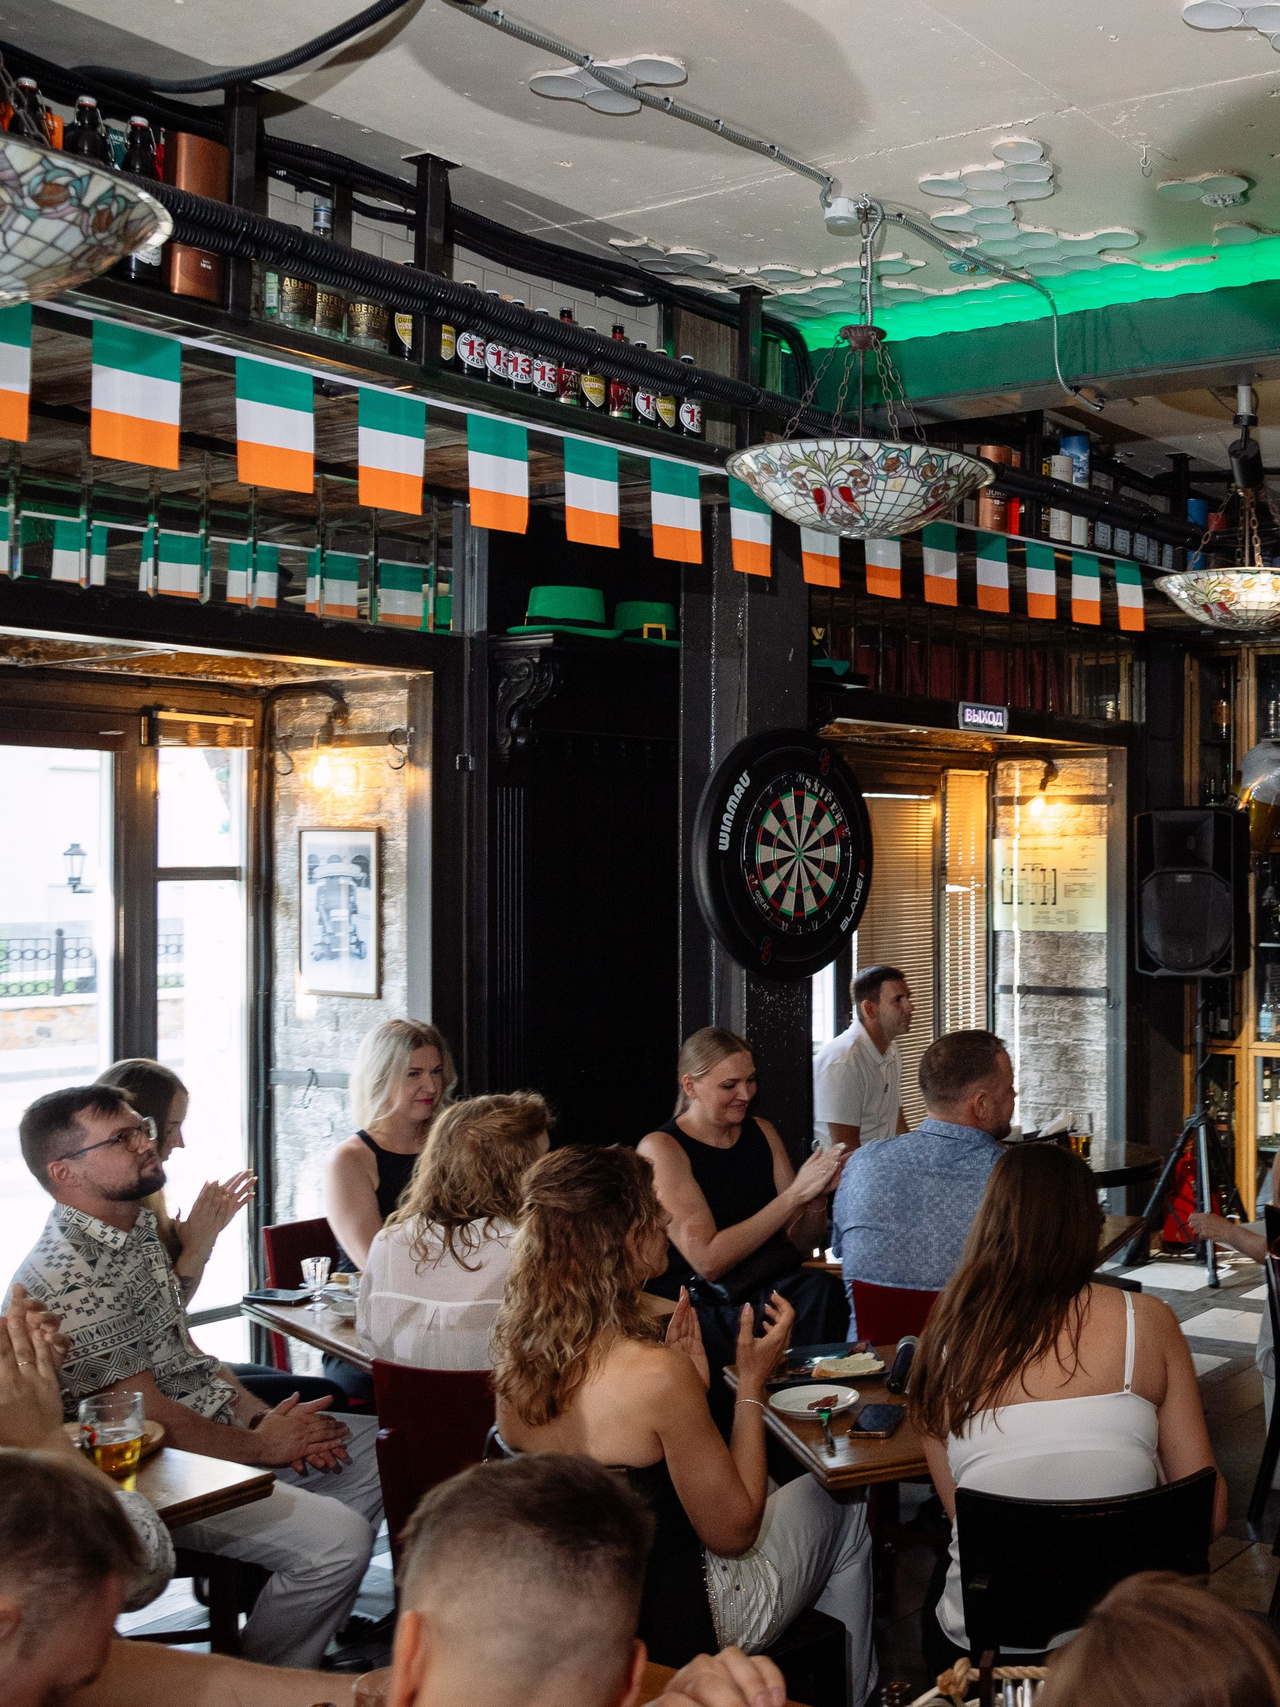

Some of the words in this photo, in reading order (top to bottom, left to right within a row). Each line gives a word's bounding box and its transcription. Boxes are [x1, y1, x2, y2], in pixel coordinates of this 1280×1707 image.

[508, 357, 532, 374] 13
[536, 366, 557, 383] 13
[964, 708, 1003, 726] ВЫХОД
[718, 771, 751, 851] WINMAU
[805, 778, 843, 825] SNIPER
[840, 879, 864, 932] BLADE
